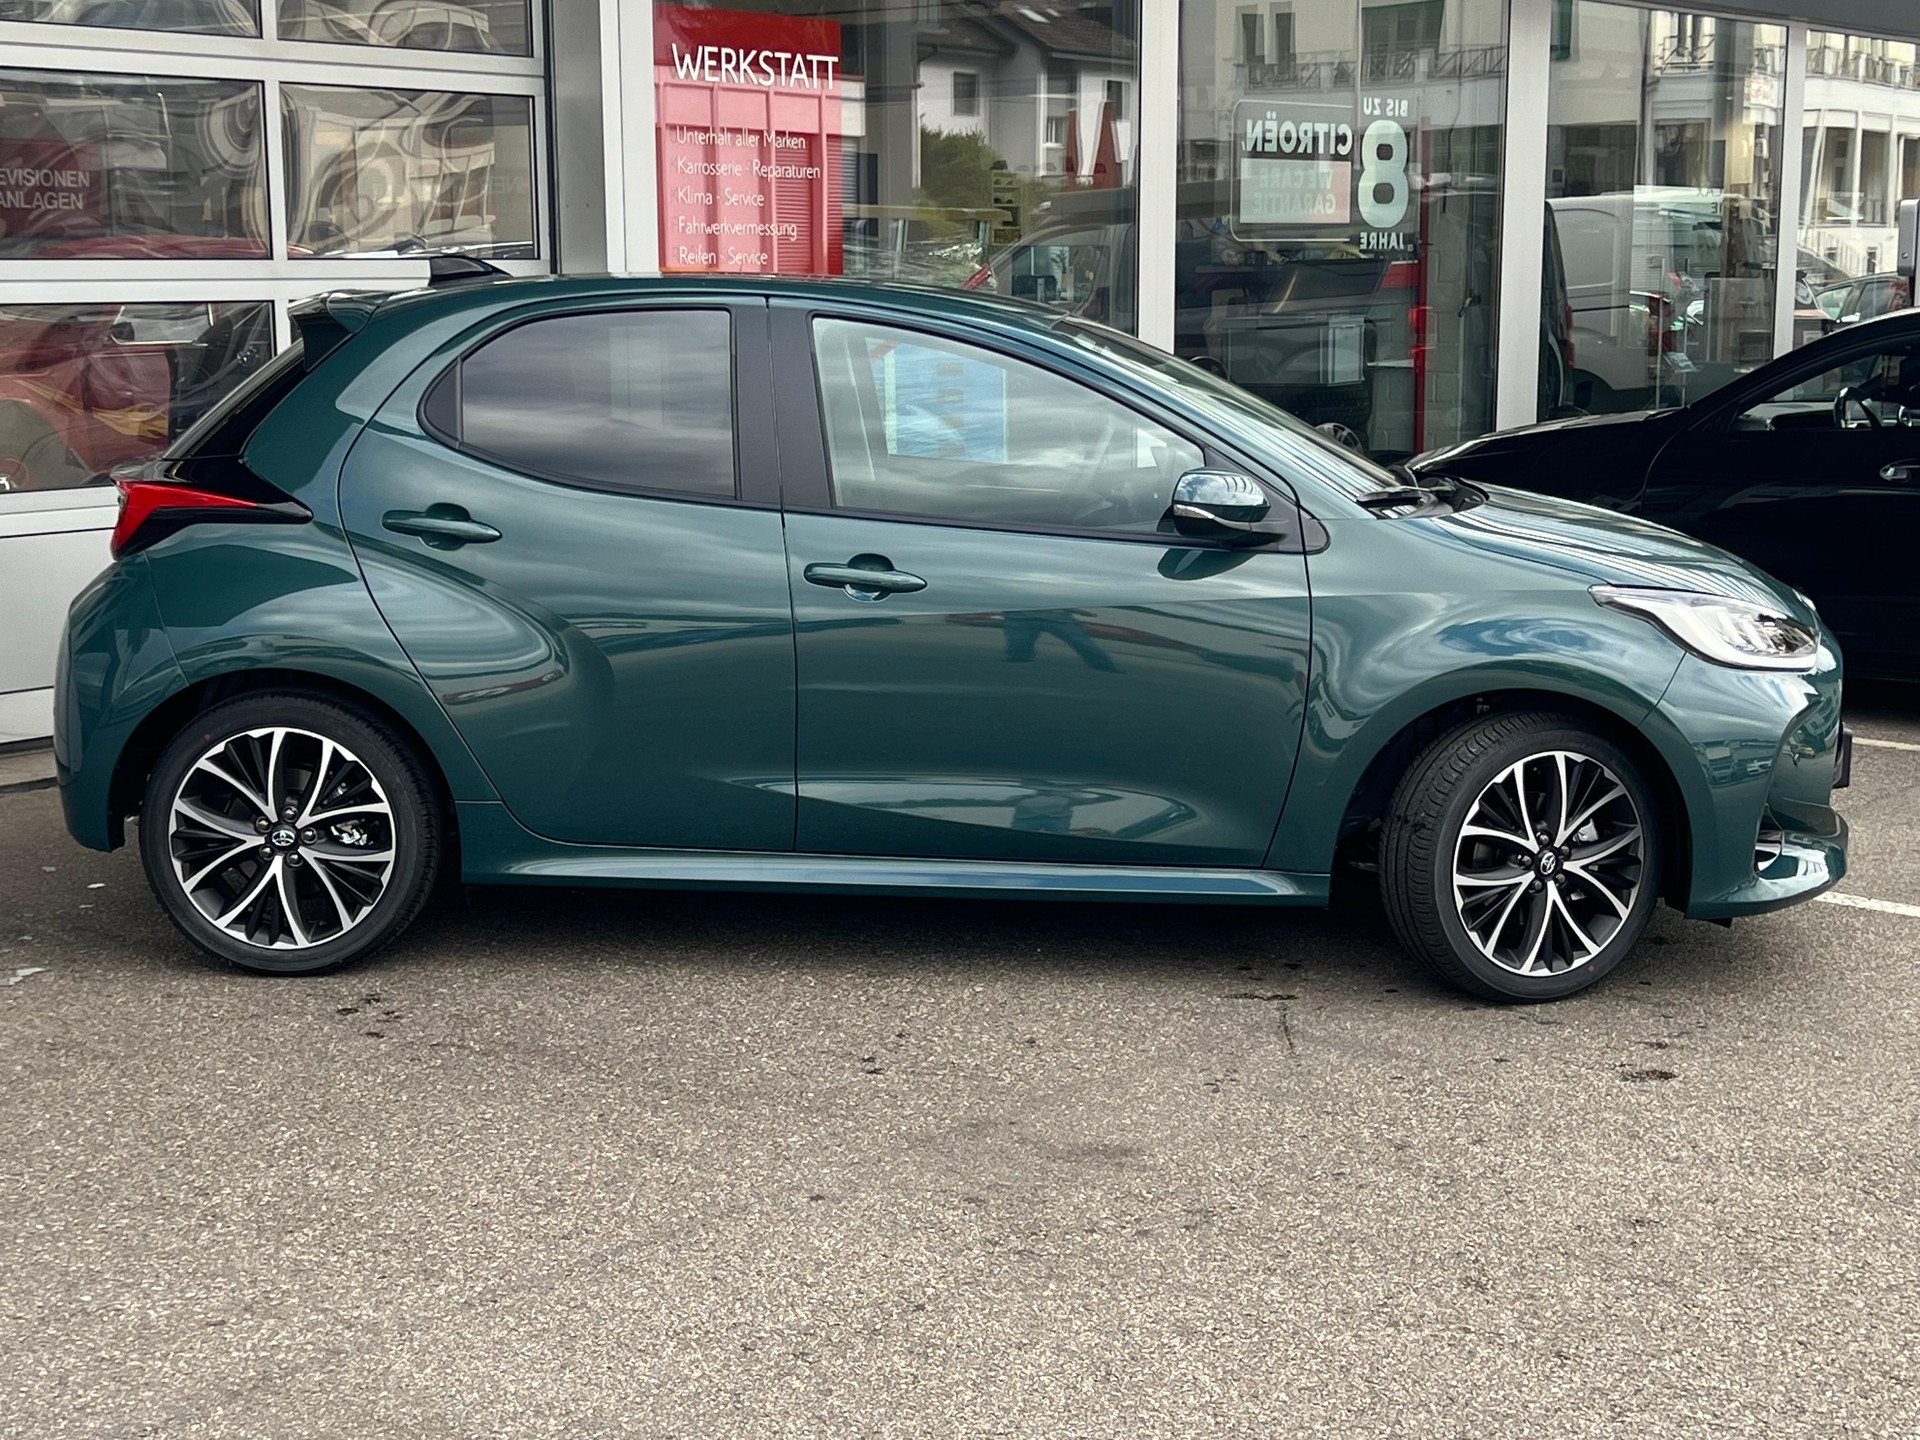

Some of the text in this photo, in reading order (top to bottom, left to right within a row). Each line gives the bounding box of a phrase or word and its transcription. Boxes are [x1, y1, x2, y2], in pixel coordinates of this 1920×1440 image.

[672, 43, 839, 90] WERKSTATT
[676, 125, 806, 150] Unterhalt aller Marken
[677, 156, 742, 177] Karrosserie
[752, 158, 821, 182] Reparaturen
[678, 185, 713, 206] Klima
[724, 187, 765, 207] Service
[678, 216, 798, 242] Fahrwerkvermessung
[680, 245, 717, 265] Reifen
[728, 246, 769, 266] Service
